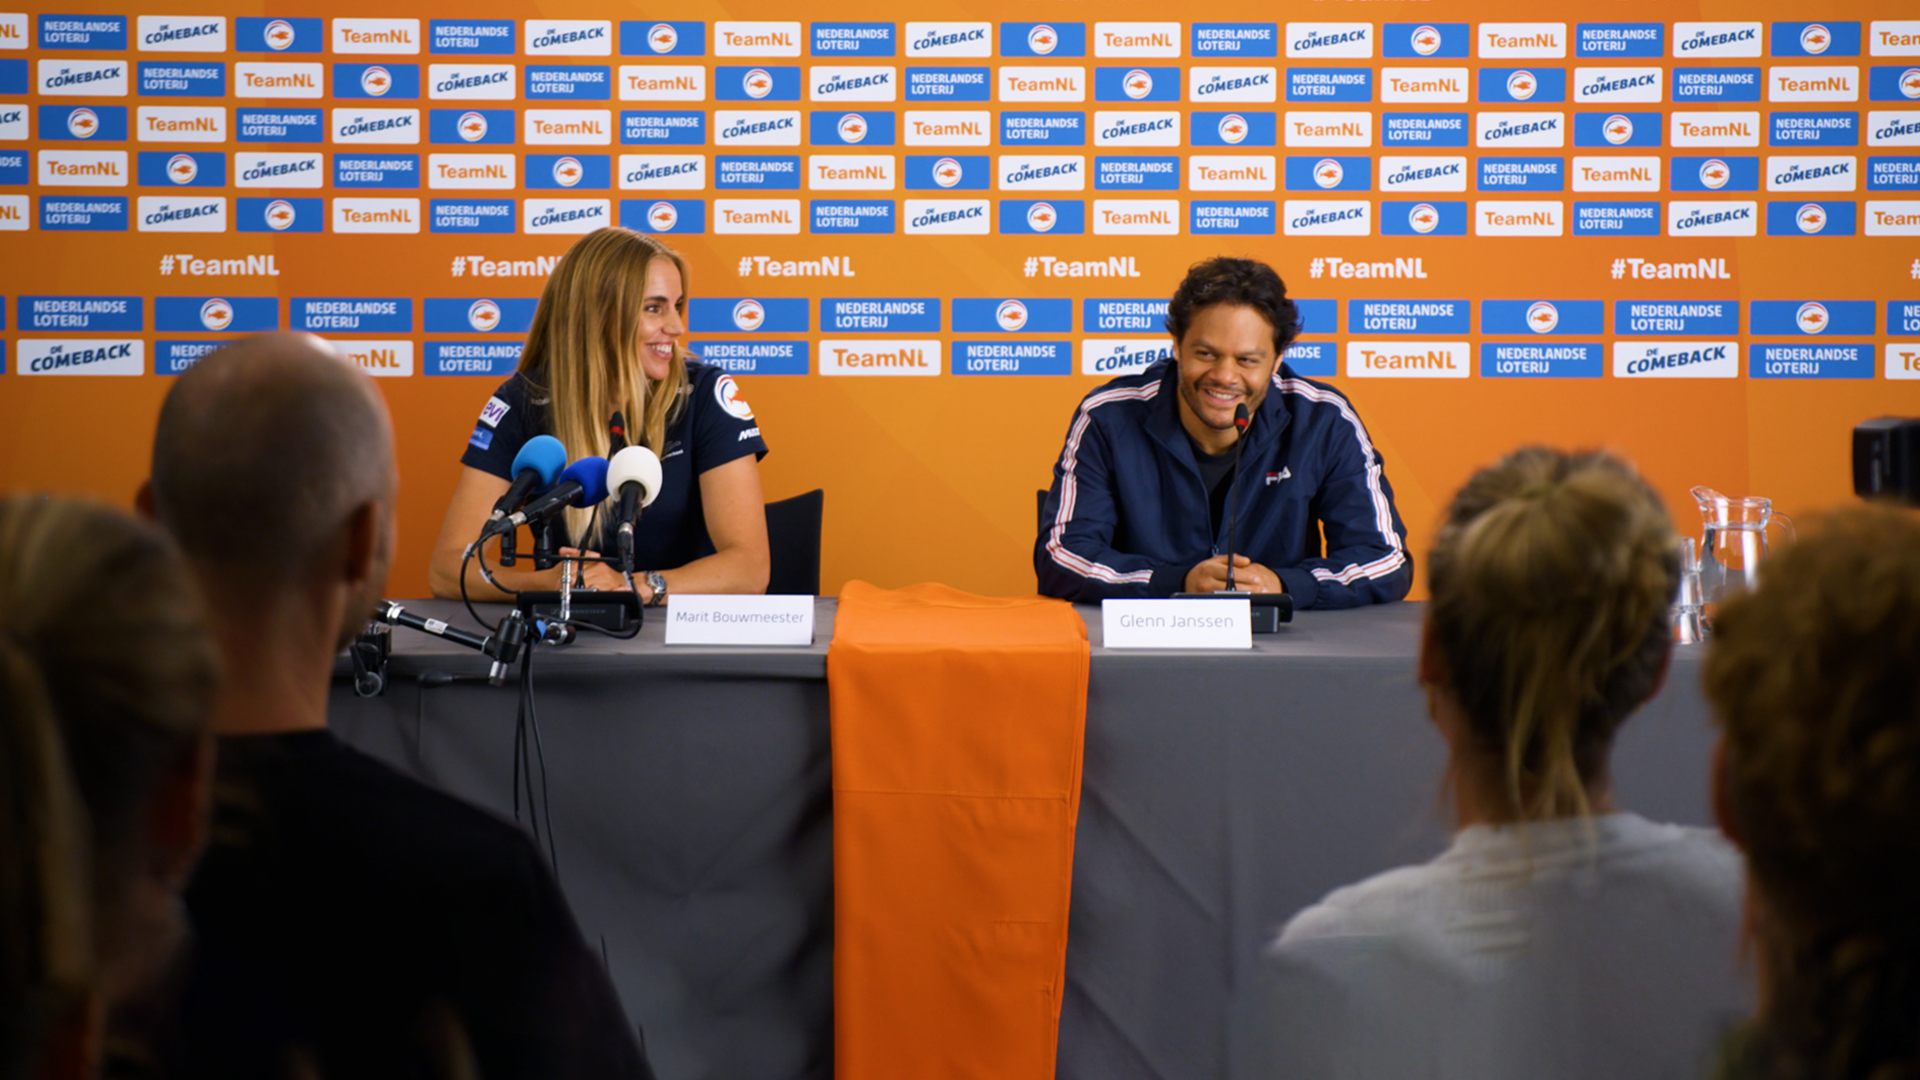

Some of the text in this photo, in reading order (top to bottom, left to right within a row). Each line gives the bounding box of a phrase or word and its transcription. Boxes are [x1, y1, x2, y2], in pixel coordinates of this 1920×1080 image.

[44, 20, 121, 32] NEDERLANDSE
[435, 25, 509, 36] NEDERLANDSE
[44, 33, 90, 43] LOTERIJ
[146, 23, 219, 44] COMEBACK
[341, 29, 412, 43] TeamNL
[533, 27, 604, 48] COMEBACK
[723, 32, 793, 46] TeamNL
[816, 28, 890, 39] NEDERLANDSE
[914, 28, 985, 50] COMEBACK
[1103, 33, 1173, 47] TeamNL
[1197, 29, 1271, 39] NEDERLANDSE
[1294, 29, 1366, 50] COMEBACK
[1582, 29, 1657, 39] NEDERLANDSE
[1682, 28, 1755, 50] COMEBACK
[1878, 32, 1920, 46] Team
[435, 37, 479, 48] LOTERIJ
[816, 40, 860, 51] LOTERIJ
[1197, 41, 1241, 51] LOTERIJ
[1486, 34, 1558, 47] TeamNL
[1582, 41, 1627, 51] LOTERIJ
[46, 67, 120, 88] COMEBACK
[143, 67, 219, 79] NEDERLANDSE
[531, 71, 605, 82] NEDERLANDSE
[911, 73, 984, 83] NEDERLANDSE
[1292, 73, 1366, 84] NEDERLANDSE
[1678, 73, 1754, 84] NEDERLANDSE
[143, 80, 189, 90] LOTERIJ
[243, 73, 316, 87] TeamNL
[437, 71, 508, 92] COMEBACK
[627, 76, 697, 90] TeamNL
[818, 73, 889, 94] COMEBACK
[1007, 78, 1077, 91] TeamNL
[1198, 73, 1269, 95] COMEBACK
[1389, 79, 1460, 92] TeamNL
[1583, 73, 1655, 95] COMEBACK
[1777, 77, 1850, 91] TeamNL
[531, 83, 575, 94] LOTERIJ
[911, 85, 955, 95] LOTERIJ
[1292, 85, 1336, 96] LOTERIJ
[1678, 86, 1723, 96] LOTERIJ
[146, 117, 218, 131] TeamNL
[242, 114, 317, 125] NEDERLANDSE
[340, 115, 412, 136] COMEBACK
[625, 116, 699, 127] NEDERLANDSE
[1006, 117, 1079, 128] NEDERLANDSE
[1388, 118, 1462, 129] NEDERLANDSE
[1775, 117, 1852, 128] NEDERLANDSE
[242, 126, 287, 136] LOTERIJ
[533, 121, 603, 134] TeamNL
[626, 128, 670, 139] LOTERIJ
[723, 117, 794, 138] COMEBACK
[912, 122, 982, 135] TeamNL
[1102, 117, 1173, 139] COMEBACK
[1293, 123, 1363, 136] TeamNL
[1485, 118, 1557, 140] COMEBACK
[1679, 123, 1751, 136] TeamNL
[1876, 119, 1920, 139] COMEB
[1006, 129, 1050, 140] LOTERIJ
[1388, 130, 1432, 141] LOTERIJ
[1775, 130, 1821, 140] LOTERIJ
[47, 161, 120, 175] TeamNL
[243, 159, 316, 180] COMEBACK
[339, 159, 414, 170] NEDERLANDSE
[720, 161, 794, 172] NEDERLANDSE
[1100, 162, 1174, 172] NEDERLANDSE
[1483, 163, 1558, 173] NEDERLANDSE
[1873, 162, 1920, 173] NEDERLA
[339, 171, 384, 182] LOTERIJ
[437, 165, 508, 178] TeamNL
[627, 161, 698, 182] COMEBACK
[817, 166, 887, 179] TeamNL
[1007, 162, 1078, 183] COMEBACK
[1197, 167, 1267, 180] TeamNL
[1388, 163, 1460, 184] COMEBACK
[1581, 168, 1652, 181] TeamNL
[1775, 162, 1849, 184] COMEBACK
[720, 173, 765, 184] LOTERIJ
[1100, 174, 1144, 184] LOTERIJ
[1483, 175, 1528, 185] LOTERIJ
[1873, 174, 1919, 185] LOTERIJ
[45, 202, 122, 213] NEDERLANDSE
[146, 203, 219, 224] COMEBACK
[435, 205, 509, 215] NEDERLANDSE
[816, 205, 889, 216] NEDERLANDSE
[1196, 206, 1269, 217] NEDERLANDSE
[1579, 207, 1654, 218] NEDERLANDSE
[45, 214, 91, 225] LOTERIJ
[341, 209, 412, 222] TeamNL
[435, 217, 480, 227] LOTERIJ
[532, 205, 604, 227] COMEBACK
[722, 210, 792, 223] TeamNL
[912, 206, 983, 227] COMEBACK
[1101, 211, 1171, 224] TeamNL
[1292, 207, 1364, 228] COMEBACK
[1484, 212, 1555, 225] TeamNL
[1677, 207, 1750, 229] COMEBACK
[1873, 212, 1920, 225] Team
[816, 217, 859, 228] LOTERIJ
[1196, 218, 1240, 229] LOTERIJ
[1579, 219, 1624, 230] LOTERIJ
[160, 254, 279, 276] #TeamNL
[451, 255, 562, 277] #TeamN
[738, 256, 855, 277] #TeamNL
[1023, 256, 1141, 277] #TeamNL
[1309, 257, 1427, 278] #TeamNL
[1610, 258, 1731, 280] #TeamNL
[33, 300, 127, 313] NEDERLANDSE
[305, 301, 397, 314] NEDERLANDSE
[835, 302, 925, 314] NEDERLANDSE
[1098, 302, 1170, 314] NEDERLAN
[1364, 303, 1454, 316] NEDERLANDSE
[1631, 304, 1723, 317] NEDERLANDSE
[33, 315, 89, 327] LOTERIJ
[305, 316, 360, 329] LOTERIJ
[835, 316, 889, 329] LOTERIJ
[1098, 317, 1152, 329] LOTERIJ
[1364, 318, 1417, 330] LOTERIJ
[1630, 319, 1685, 331] LOTERIJ
[49, 345, 63, 355] DE
[439, 345, 524, 358] NEDERLANDS
[704, 345, 793, 357] NEDERLANDSE
[967, 345, 1056, 357] NEDERLANDSE
[1114, 345, 1127, 354] DE
[1496, 347, 1587, 359] NEDERLANDSE
[1646, 348, 1659, 357] DE
[1765, 347, 1858, 360] NEDERLANDSE
[31, 344, 131, 371] COMEBACK
[832, 349, 928, 367] TeamNL
[1096, 345, 1174, 371] COMEBA
[1360, 351, 1457, 369] TeamNL
[1627, 346, 1726, 373] COMEBACK
[439, 359, 493, 372] LOTERIJ
[967, 359, 1020, 372] LOTERIJ
[1496, 361, 1550, 374] LOTERIJ
[1765, 362, 1820, 375] LOTERIJ
[676, 611, 804, 623] Marit Bouwmeester
[1120, 614, 1234, 628] Glenn Janssen
